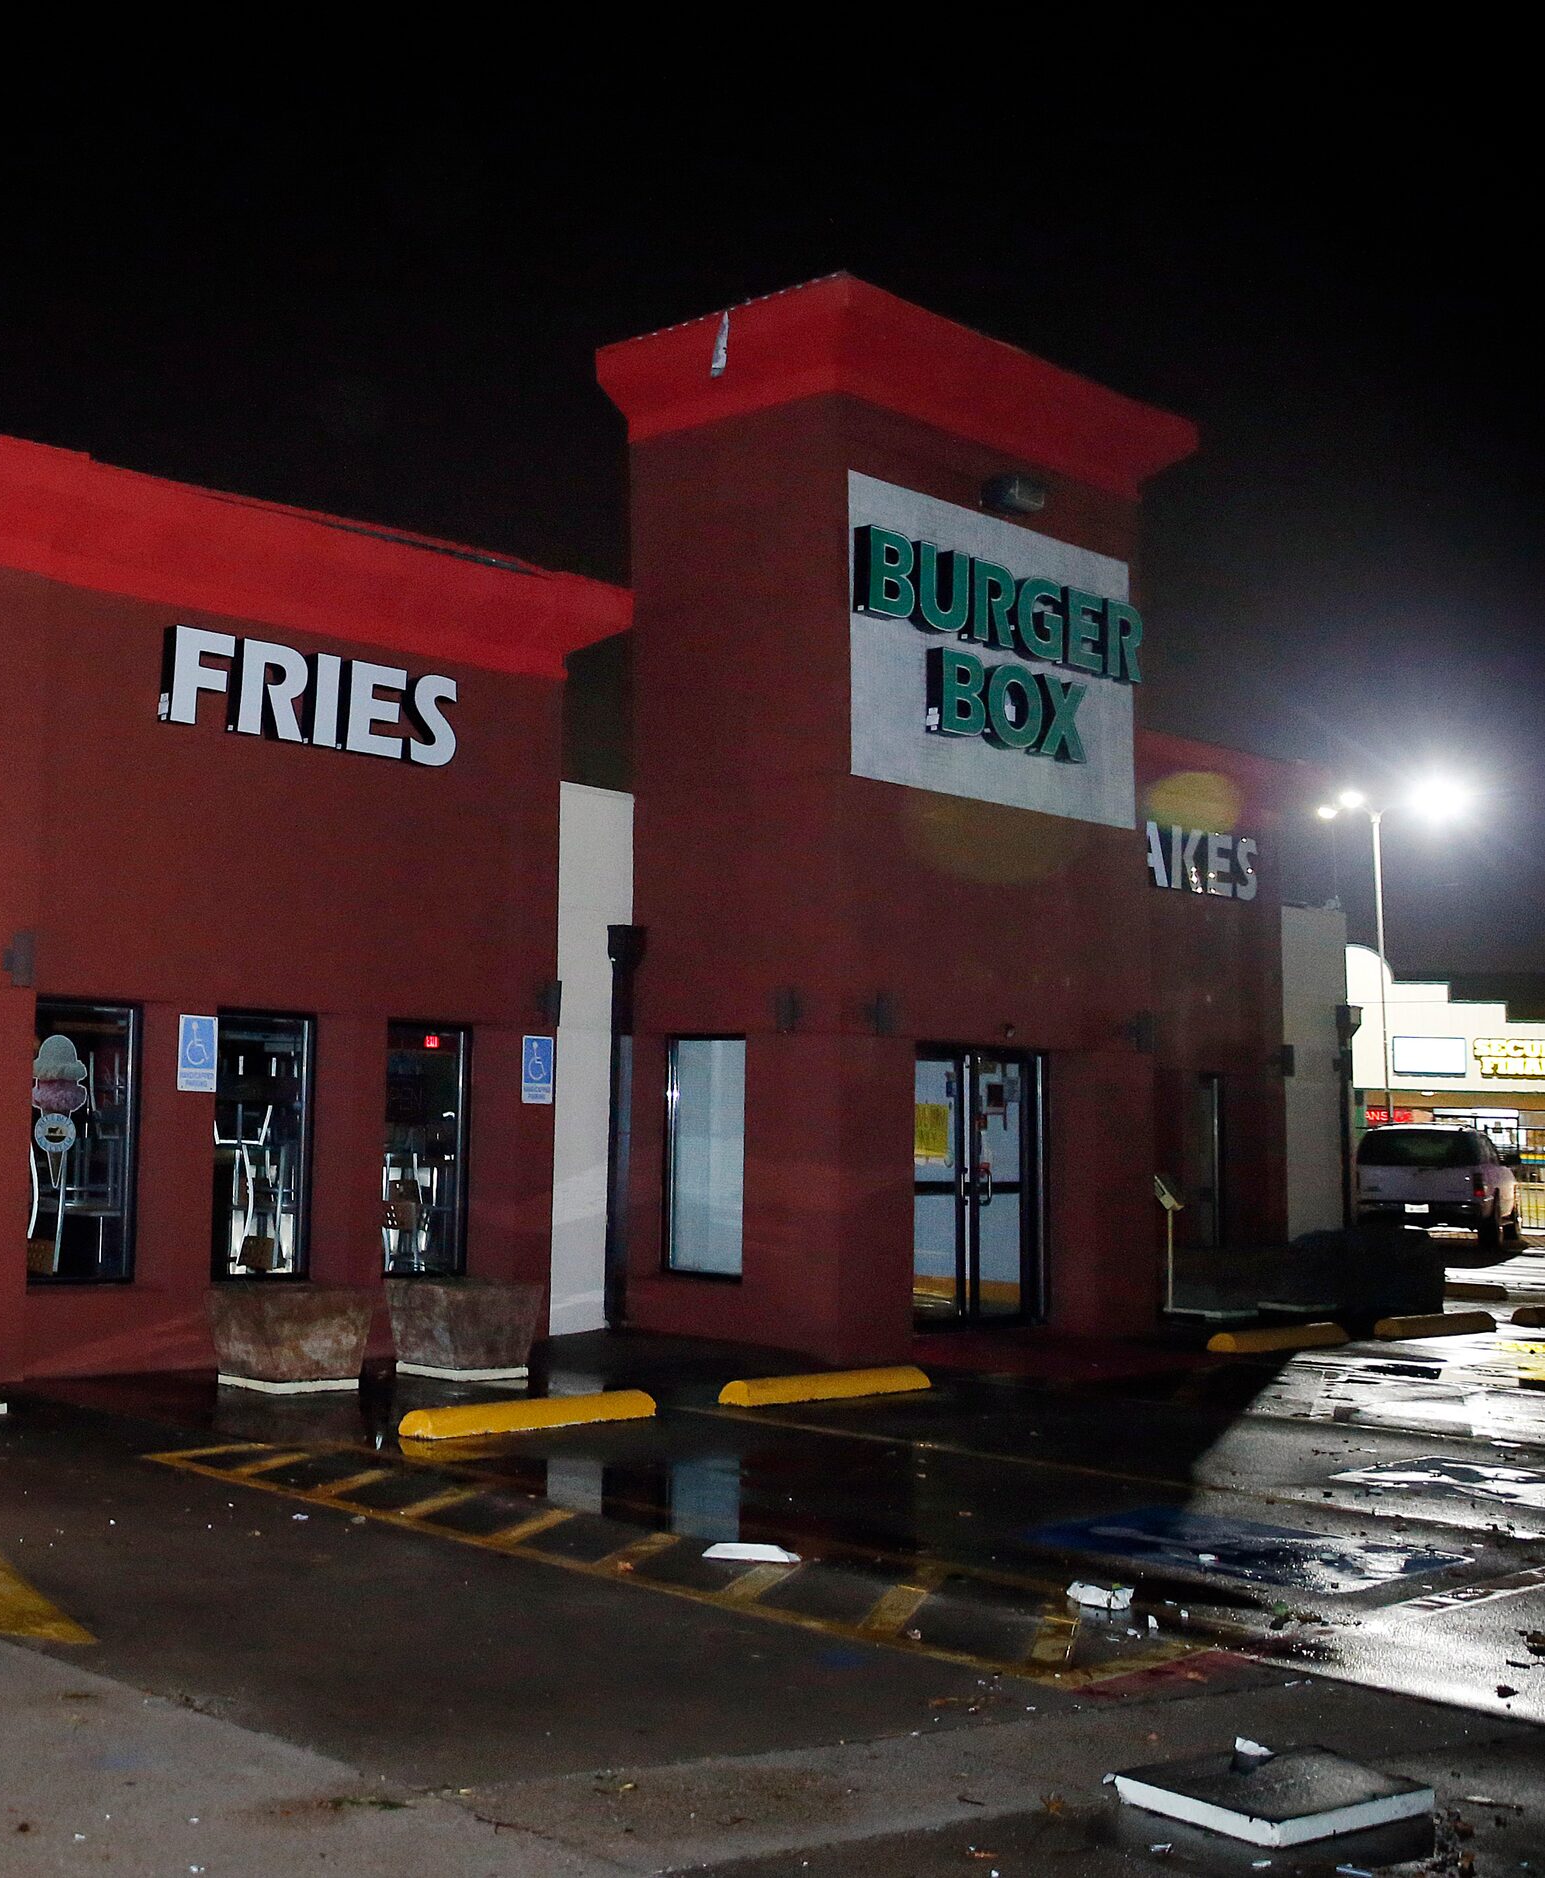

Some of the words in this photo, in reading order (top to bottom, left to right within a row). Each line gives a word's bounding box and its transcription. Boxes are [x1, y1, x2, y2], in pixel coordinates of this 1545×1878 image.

[866, 524, 1144, 684] BURGER
[169, 624, 458, 767] FRIES
[940, 646, 1088, 764] BOX
[1474, 1038, 1545, 1057] SECU
[1481, 1057, 1545, 1077] FINA
